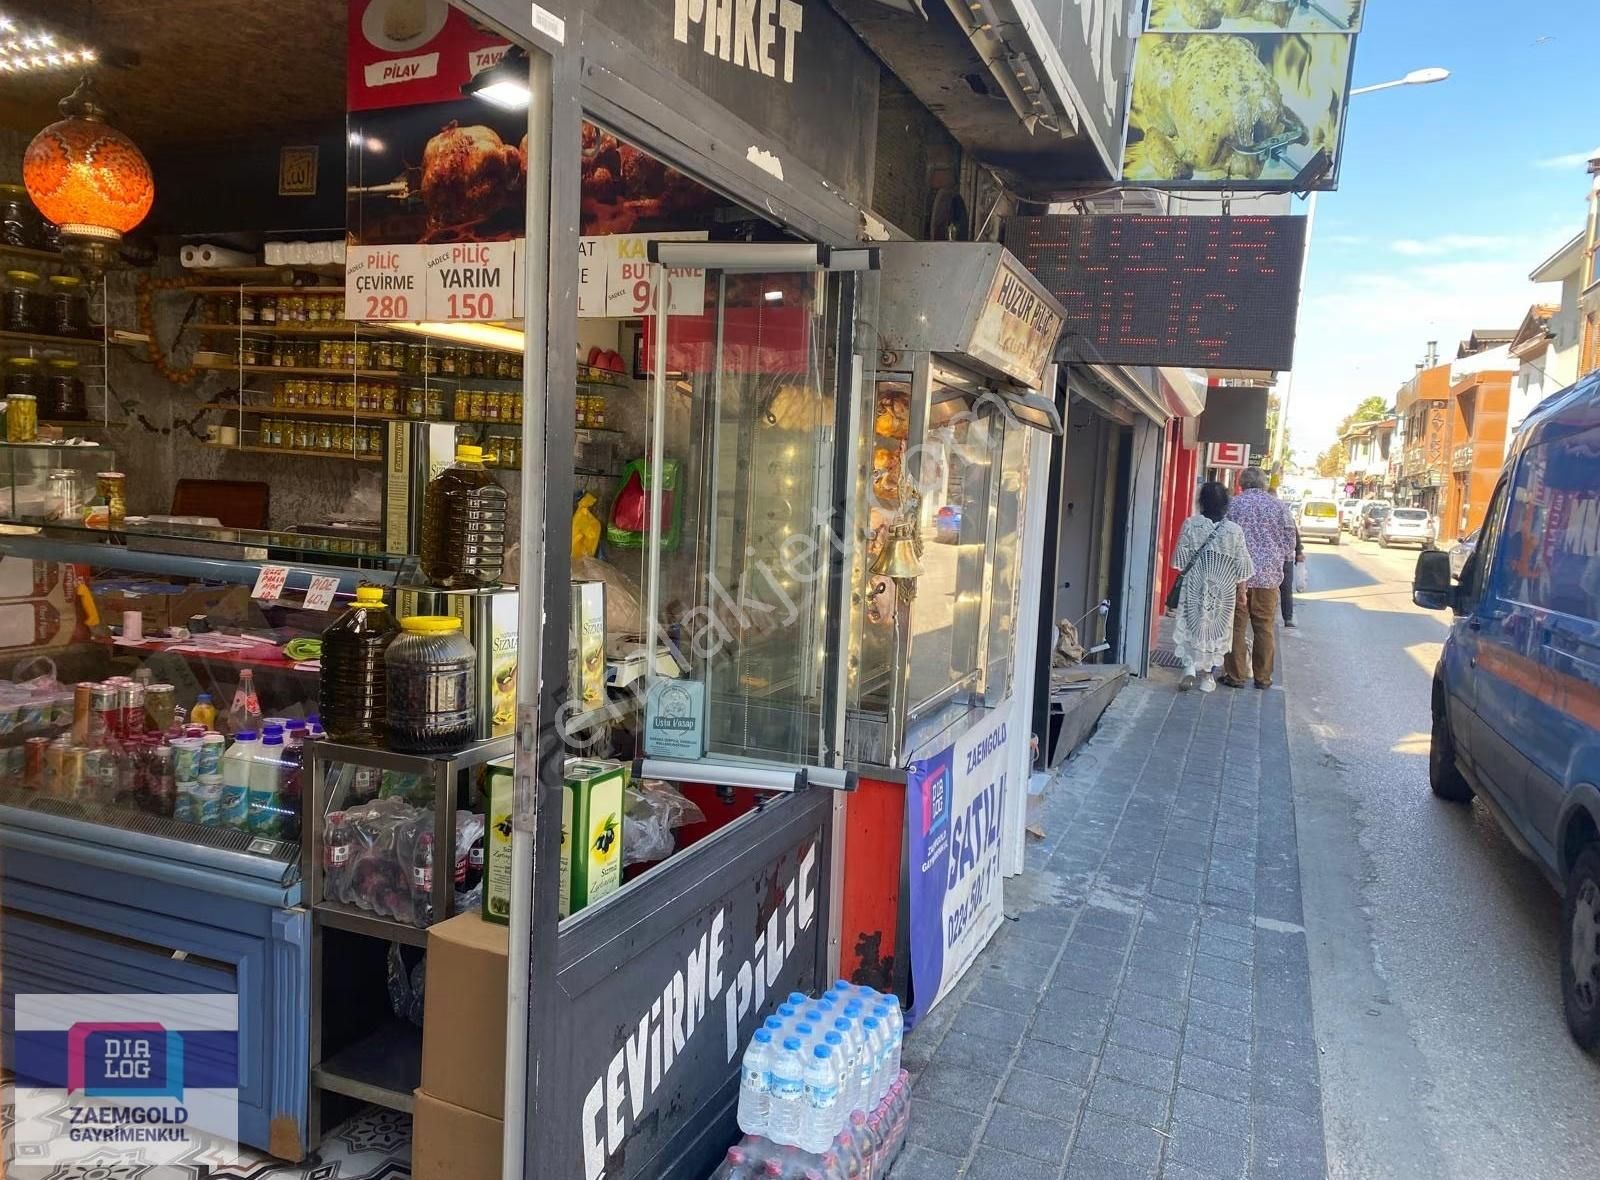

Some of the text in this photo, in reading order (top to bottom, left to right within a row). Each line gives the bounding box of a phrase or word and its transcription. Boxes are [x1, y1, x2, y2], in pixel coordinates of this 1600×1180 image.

[674, 0, 803, 83] PAKET
[475, 51, 505, 66] TAV
[383, 63, 420, 80] PİLAV
[367, 251, 400, 273] PİLİÇ
[427, 252, 450, 269] SADECE
[452, 243, 490, 267] PİLİÇ
[355, 272, 414, 294] ÇEVİRME
[439, 267, 501, 289] YARIM
[365, 295, 408, 319] 280
[447, 292, 494, 319] 150
[997, 272, 1035, 324] HUZUR
[966, 722, 1007, 775] ZAEMGOLD
[949, 772, 1006, 891] SATILI
[725, 842, 815, 1064] PİLİÇ
[582, 907, 725, 1180] ÇEVİRME
